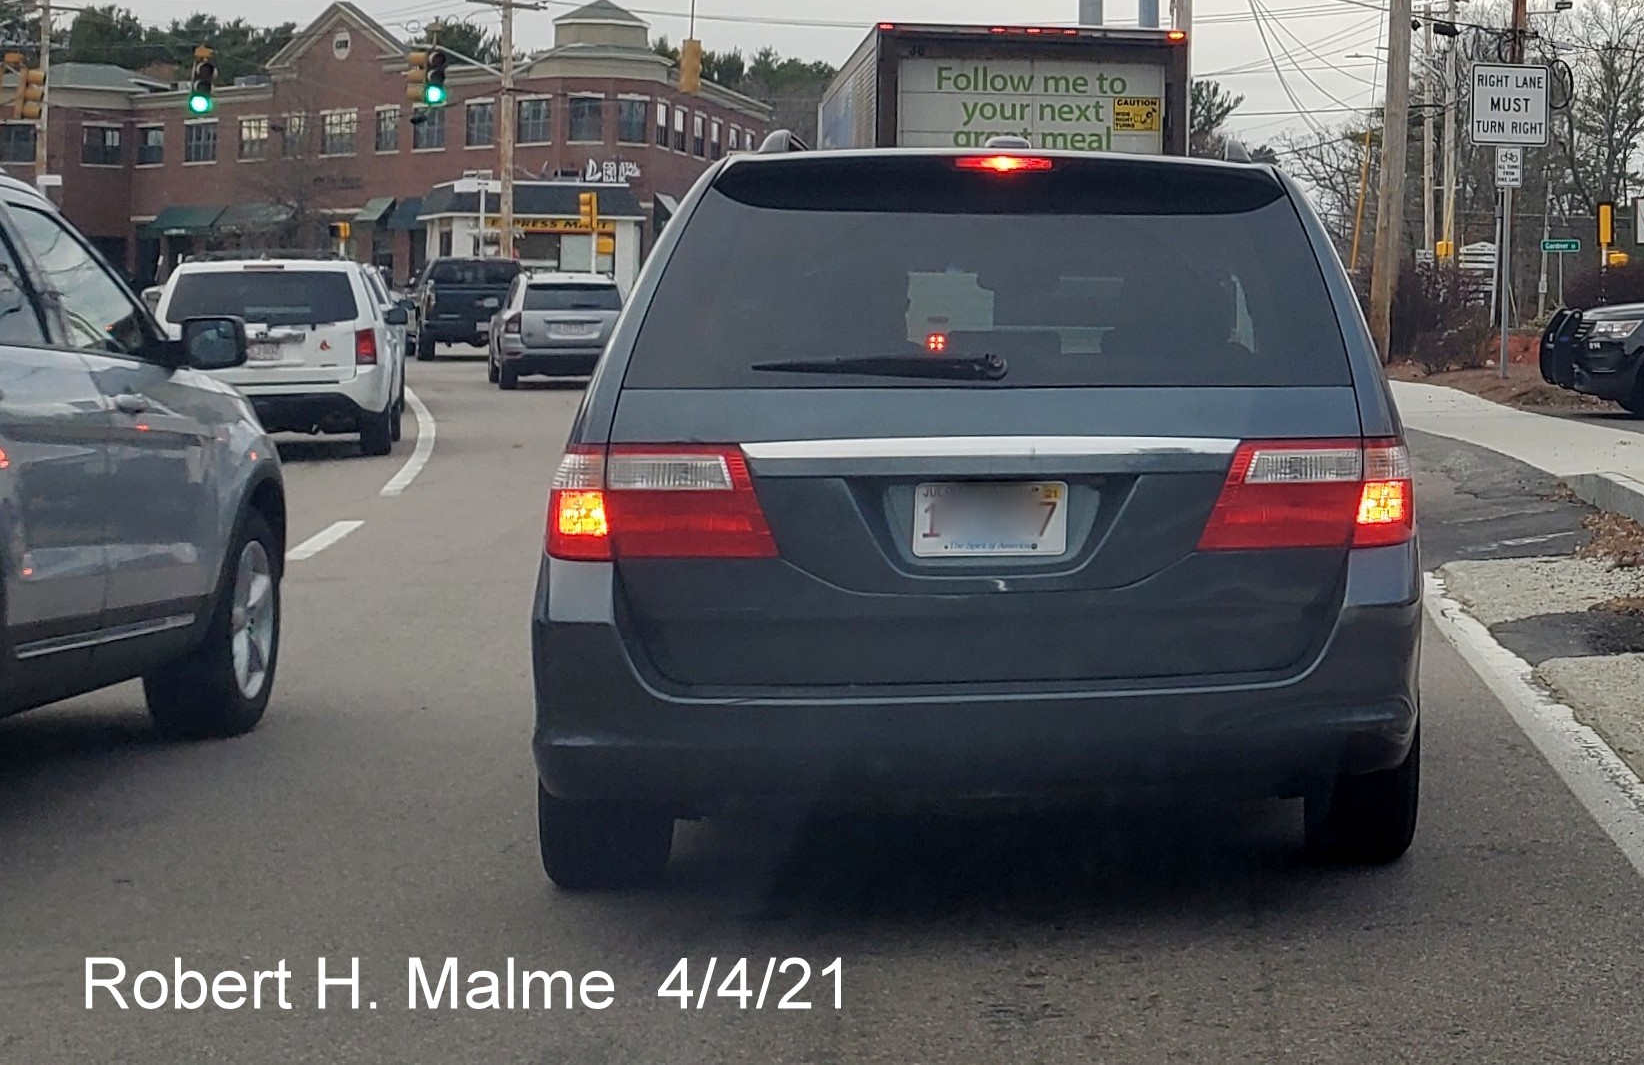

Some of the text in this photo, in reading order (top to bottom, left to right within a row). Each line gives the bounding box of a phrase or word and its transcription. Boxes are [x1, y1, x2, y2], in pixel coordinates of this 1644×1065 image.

[937, 66, 1128, 95] Follow me to
[1477, 74, 1543, 89] RIGHT LANE
[1490, 96, 1531, 113] MUST
[961, 100, 1105, 126] your next
[1476, 120, 1544, 135] TURN RIGHT
[1041, 126, 1112, 151] meal
[490, 219, 558, 228] EPRESS
[1045, 489, 1058, 498] 21
